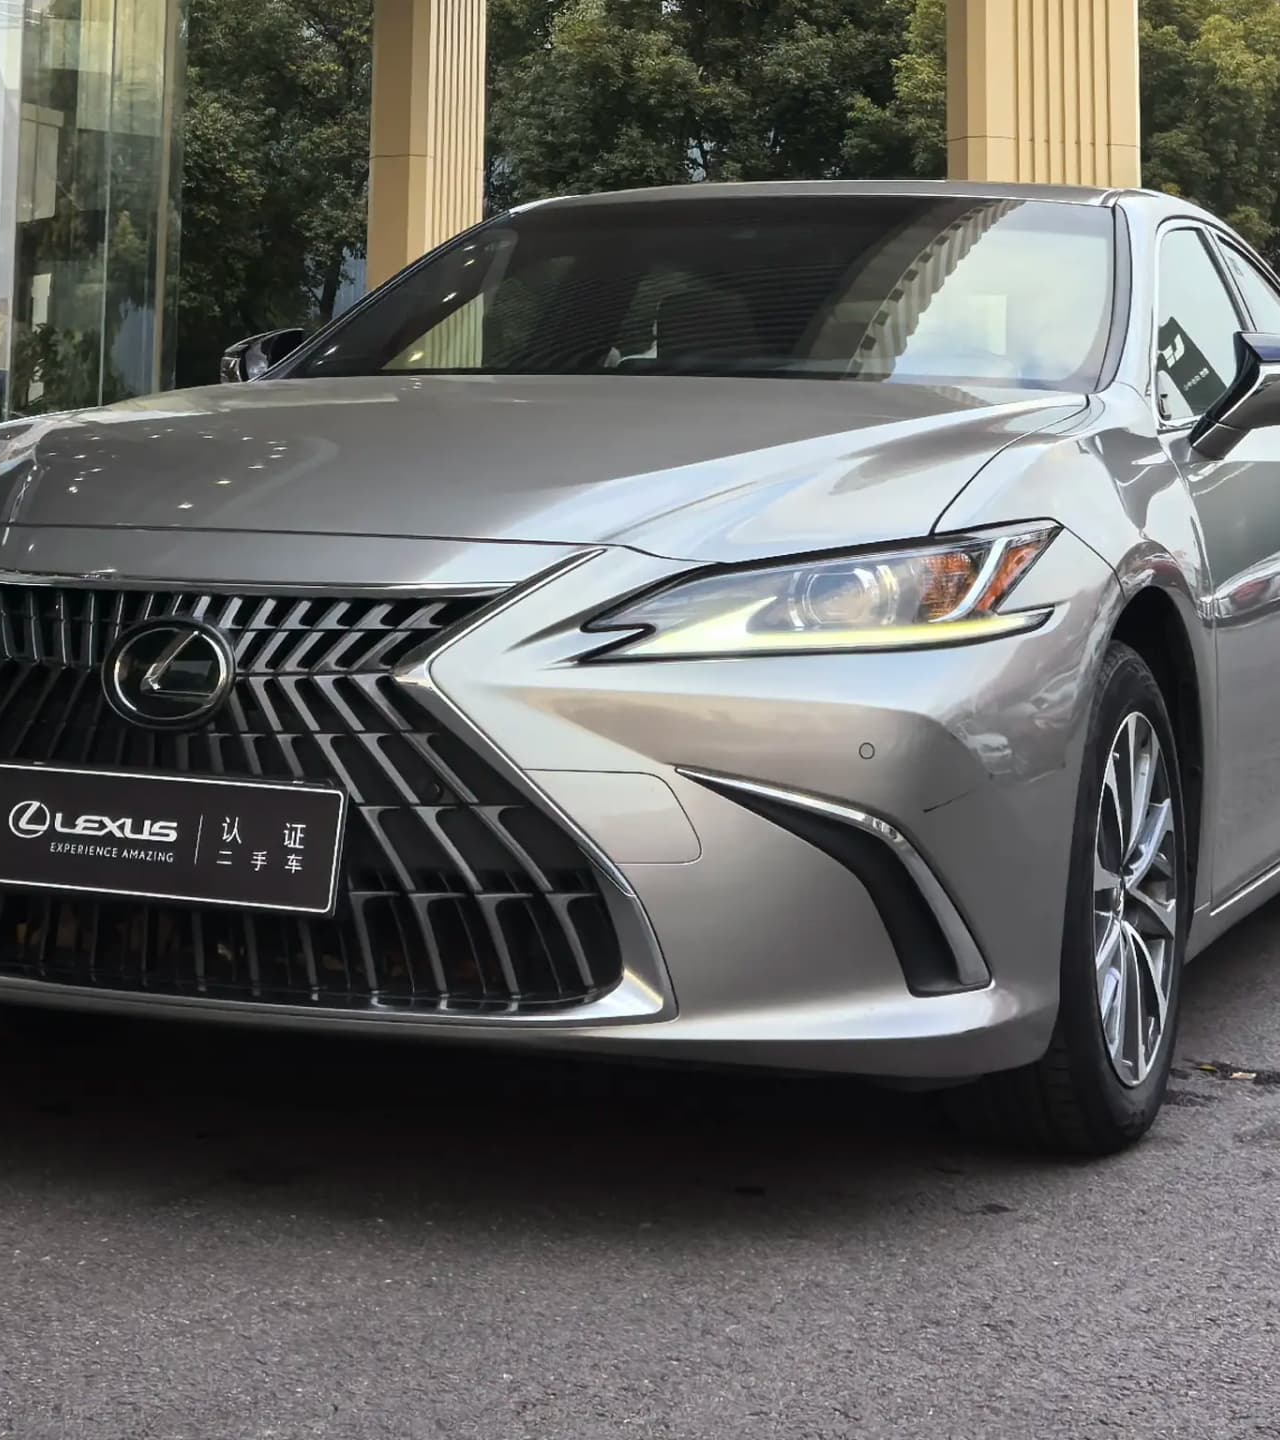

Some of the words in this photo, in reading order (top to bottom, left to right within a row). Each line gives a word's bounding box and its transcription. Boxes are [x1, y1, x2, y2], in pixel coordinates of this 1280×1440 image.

[54, 812, 178, 842] LEXUS
[49, 842, 118, 858] EXPERIENCE
[122, 847, 174, 863] AMAZING
